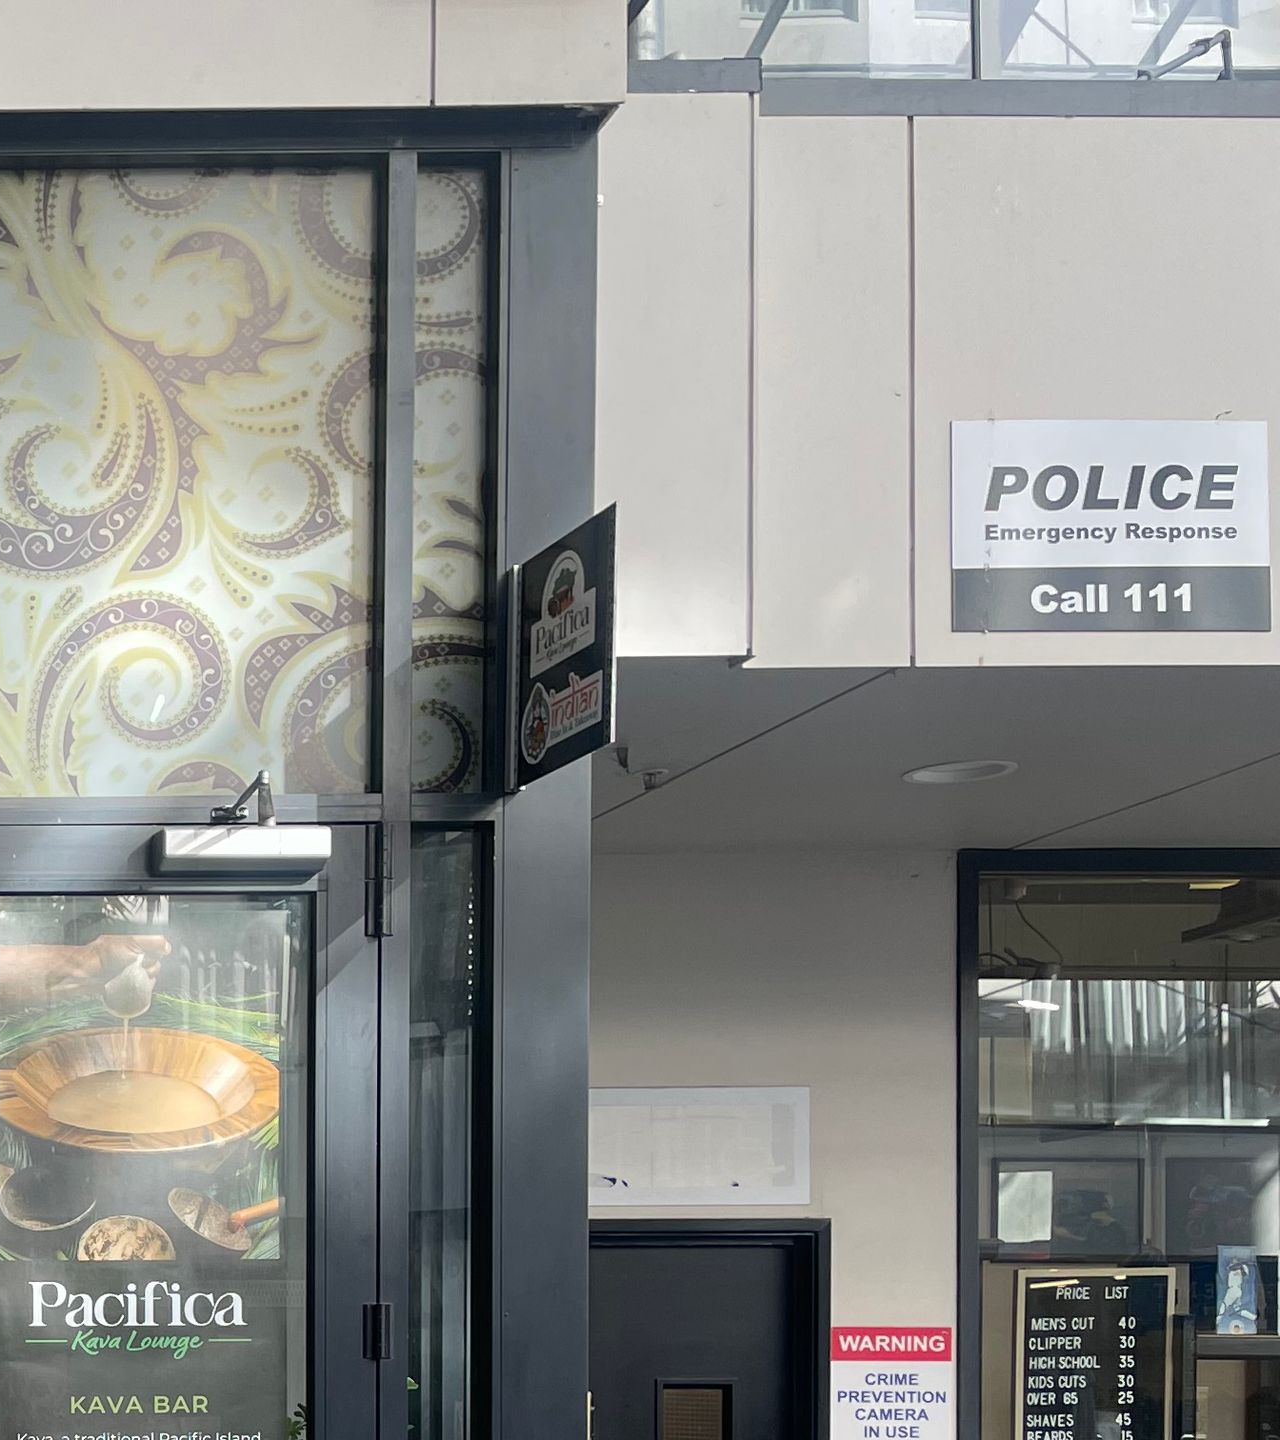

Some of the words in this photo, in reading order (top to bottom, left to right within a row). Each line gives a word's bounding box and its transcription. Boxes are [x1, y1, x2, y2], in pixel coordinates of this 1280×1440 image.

[984, 465, 1238, 512] POLICE
[985, 524, 1117, 544] Emergency
[1125, 523, 1238, 543] Response
[1030, 584, 1108, 613] Call
[1123, 583, 1192, 612] 111
[536, 606, 589, 655] Pacifica
[1056, 1287, 1090, 1300] PRICE
[1105, 1286, 1129, 1299] LIST
[28, 1280, 248, 1327] Pacifica
[1031, 1318, 1066, 1331] MEN'S
[1072, 1317, 1095, 1330] CUT
[1118, 1317, 1136, 1329] 40
[72, 1329, 121, 1355] Kava
[127, 1330, 204, 1359] Lounge
[839, 1335, 945, 1352] WARNING
[1029, 1337, 1081, 1350] CLIPPER
[1119, 1336, 1135, 1349] 30
[1029, 1356, 1055, 1370] HIGH
[1058, 1356, 1100, 1369] SCHOOL
[1119, 1355, 1135, 1368] 35
[865, 1373, 919, 1386] CRIME
[1028, 1376, 1054, 1389] KIDS
[1059, 1375, 1086, 1388] CUTS
[1117, 1375, 1134, 1388] 30
[71, 1396, 143, 1414] KAVA
[154, 1395, 209, 1413] BAR
[837, 1391, 946, 1404] PREVENTION
[1027, 1392, 1055, 1405] OVER
[1063, 1392, 1078, 1404] 65
[1118, 1391, 1134, 1404] 25
[855, 1409, 929, 1421] CAMERA
[1027, 1414, 1074, 1427] SHAVES
[1115, 1413, 1131, 1426] 45
[864, 1426, 879, 1438] IN
[886, 1426, 920, 1438] USE
